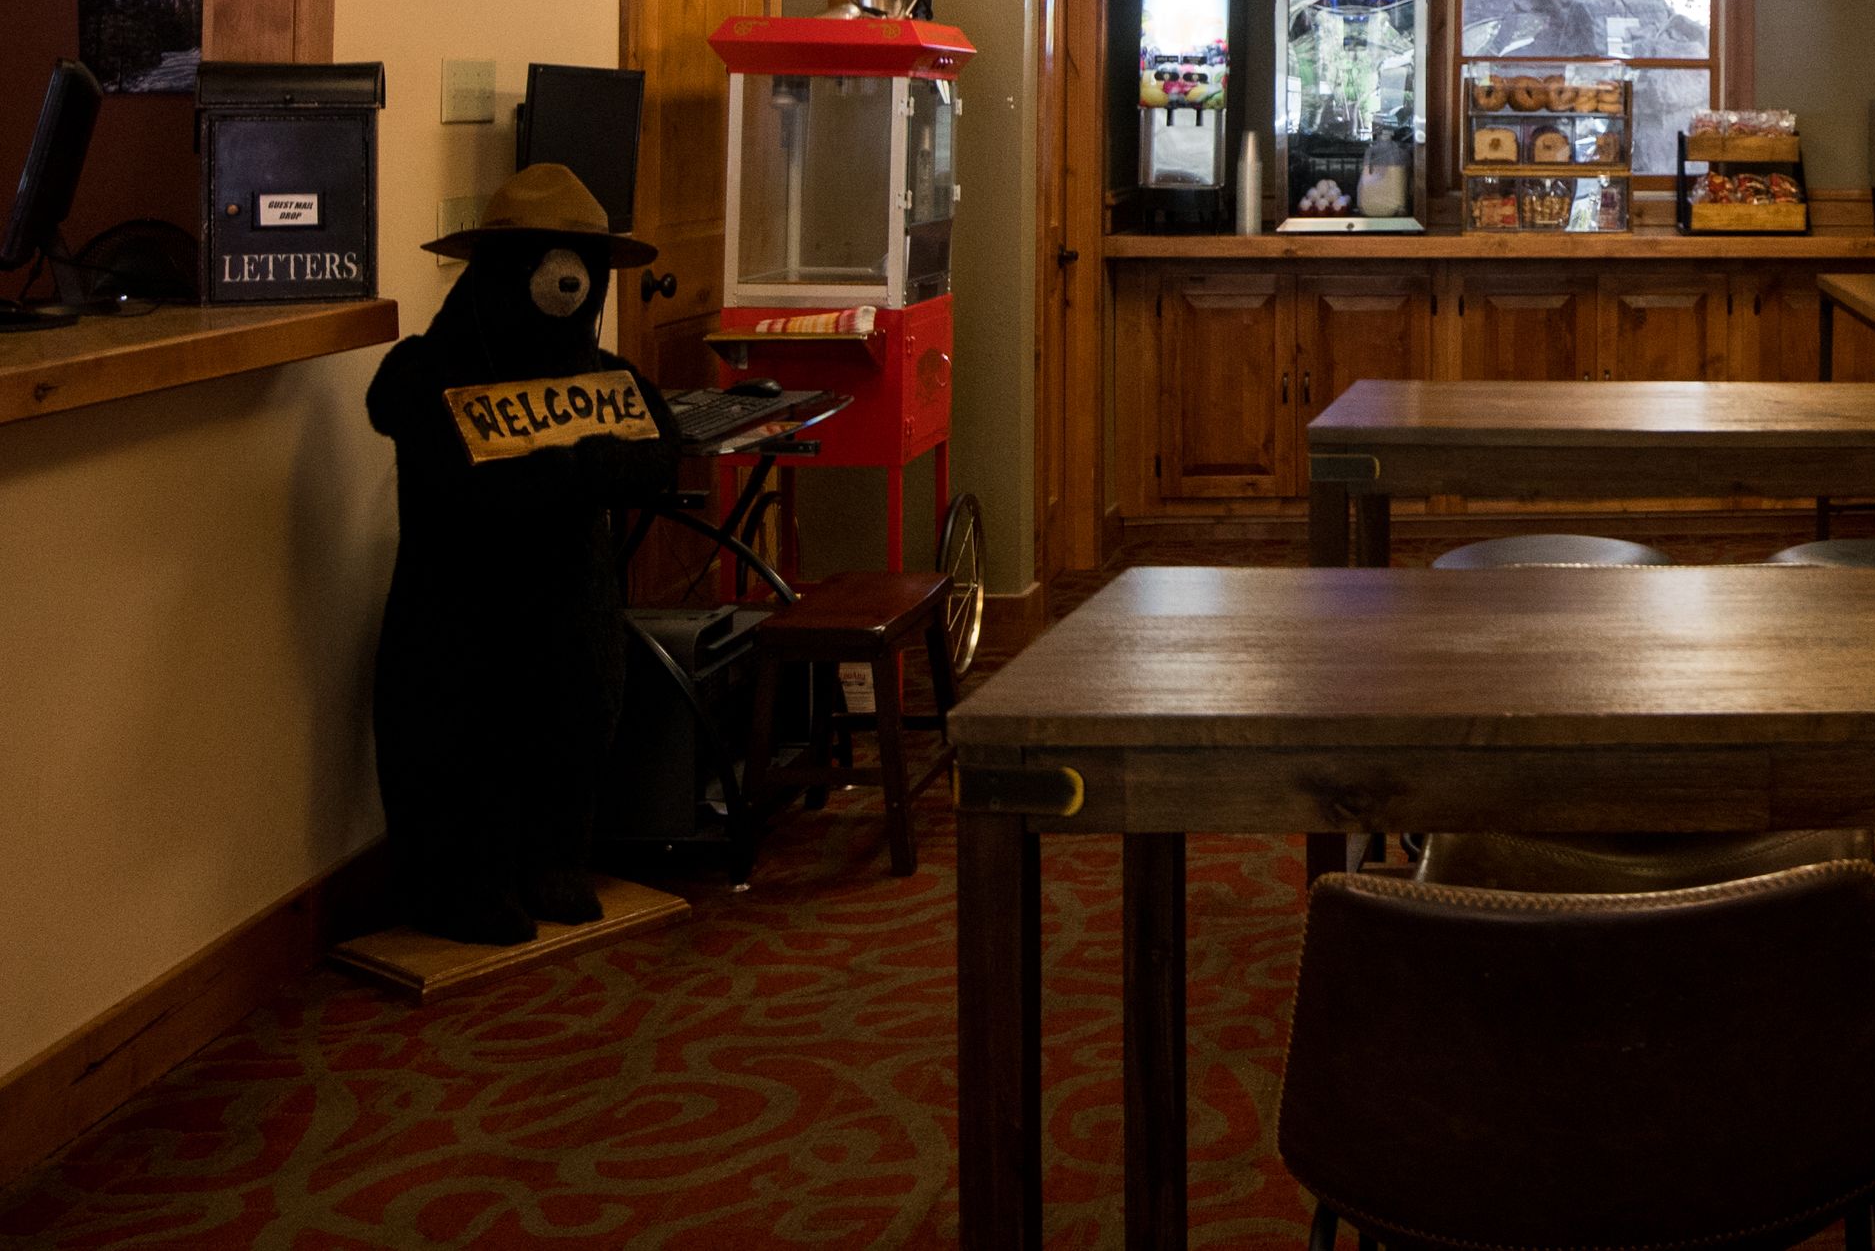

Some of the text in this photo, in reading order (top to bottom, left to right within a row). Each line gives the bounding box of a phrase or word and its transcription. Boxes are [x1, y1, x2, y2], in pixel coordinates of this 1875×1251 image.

[268, 200, 314, 210] GUEST MAIL
[279, 211, 302, 220] DROP
[222, 251, 358, 282] LETTERS
[463, 385, 646, 441] WELCOME
